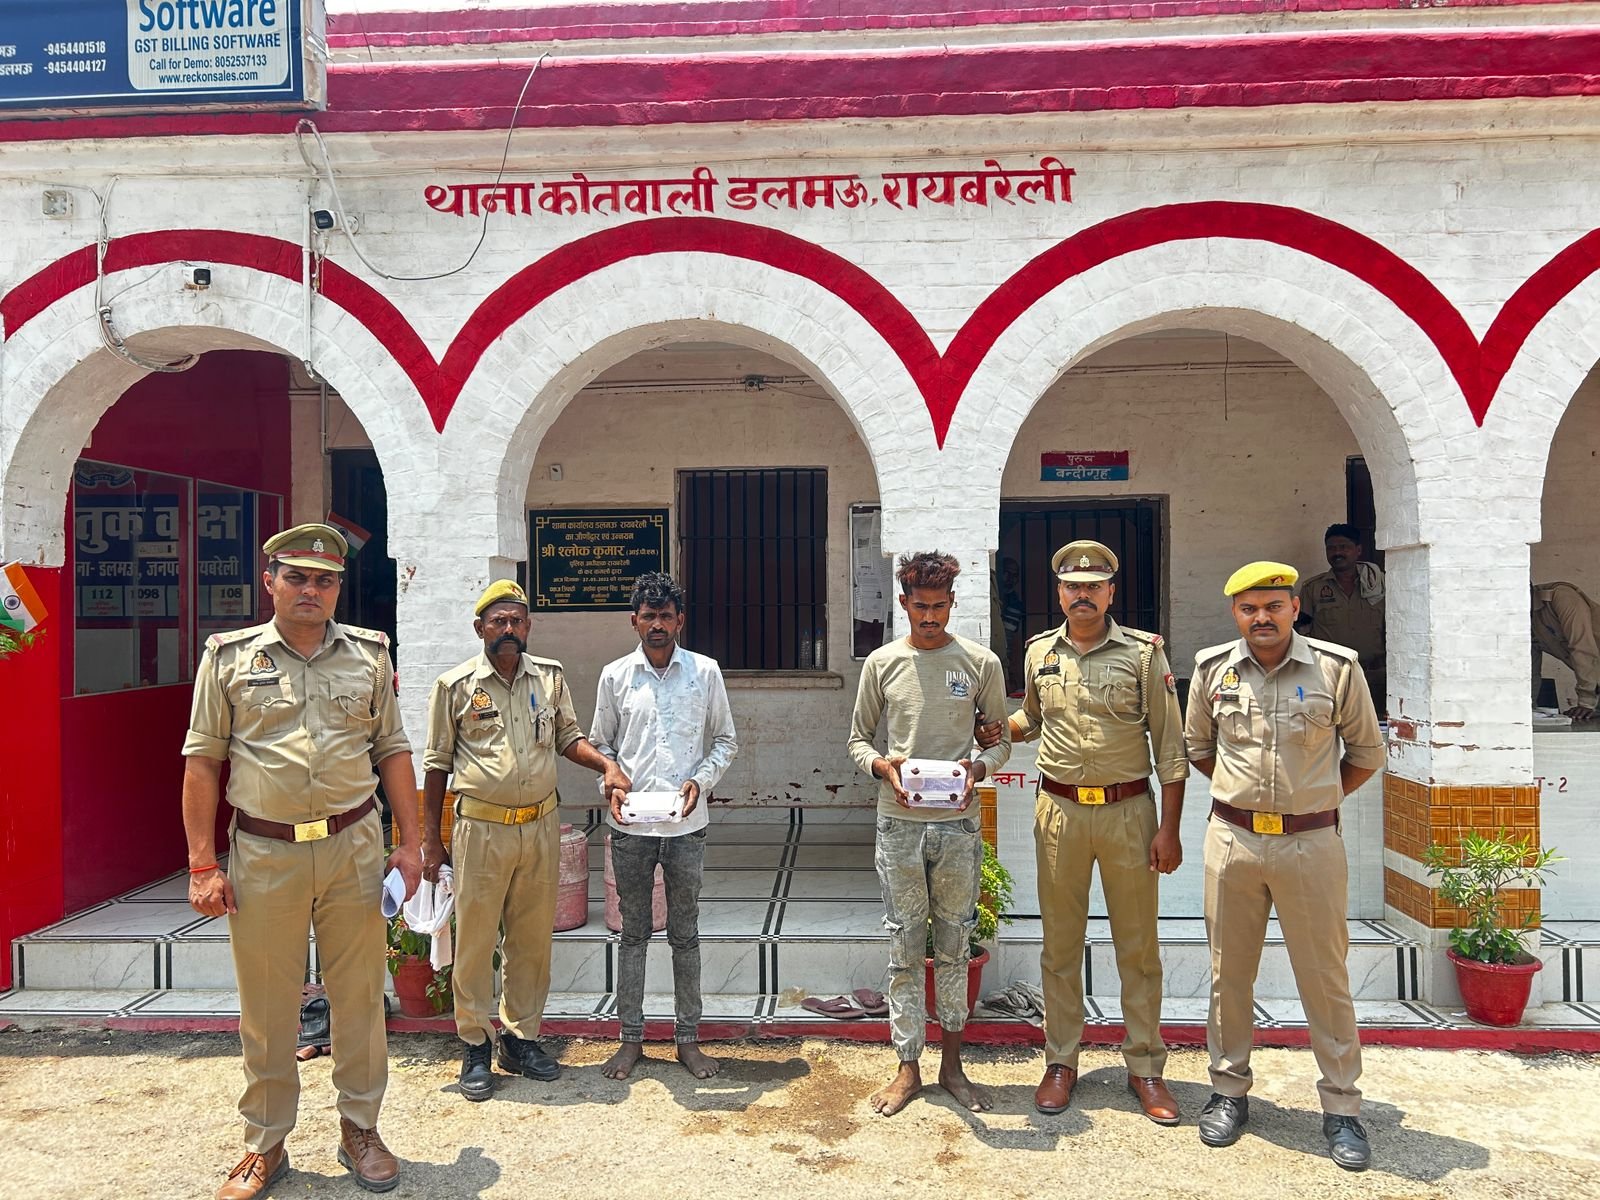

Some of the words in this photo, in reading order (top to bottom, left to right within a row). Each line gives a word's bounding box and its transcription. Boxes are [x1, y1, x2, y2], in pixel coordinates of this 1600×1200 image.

[139, 0, 276, 32] Software
[134, 39, 158, 53] GST
[162, 36, 209, 52] BILLING
[213, 33, 281, 50] SOFTWARE
[149, 58, 167, 70] Call
[168, 58, 182, 70] for
[184, 57, 212, 69] Demo:
[215, 55, 267, 68] 8052537133
[158, 70, 258, 84] www.reckonsales.com
[424, 182, 535, 217] थाना
[538, 166, 719, 216] कोतवाली
[881, 156, 1077, 210] रायबरेली
[542, 544, 555, 557] श्री
[593, 545, 625, 559] कुमार
[198, 555, 240, 577] यबरेली
[91, 588, 113, 600] 112
[220, 587, 242, 599] 108
